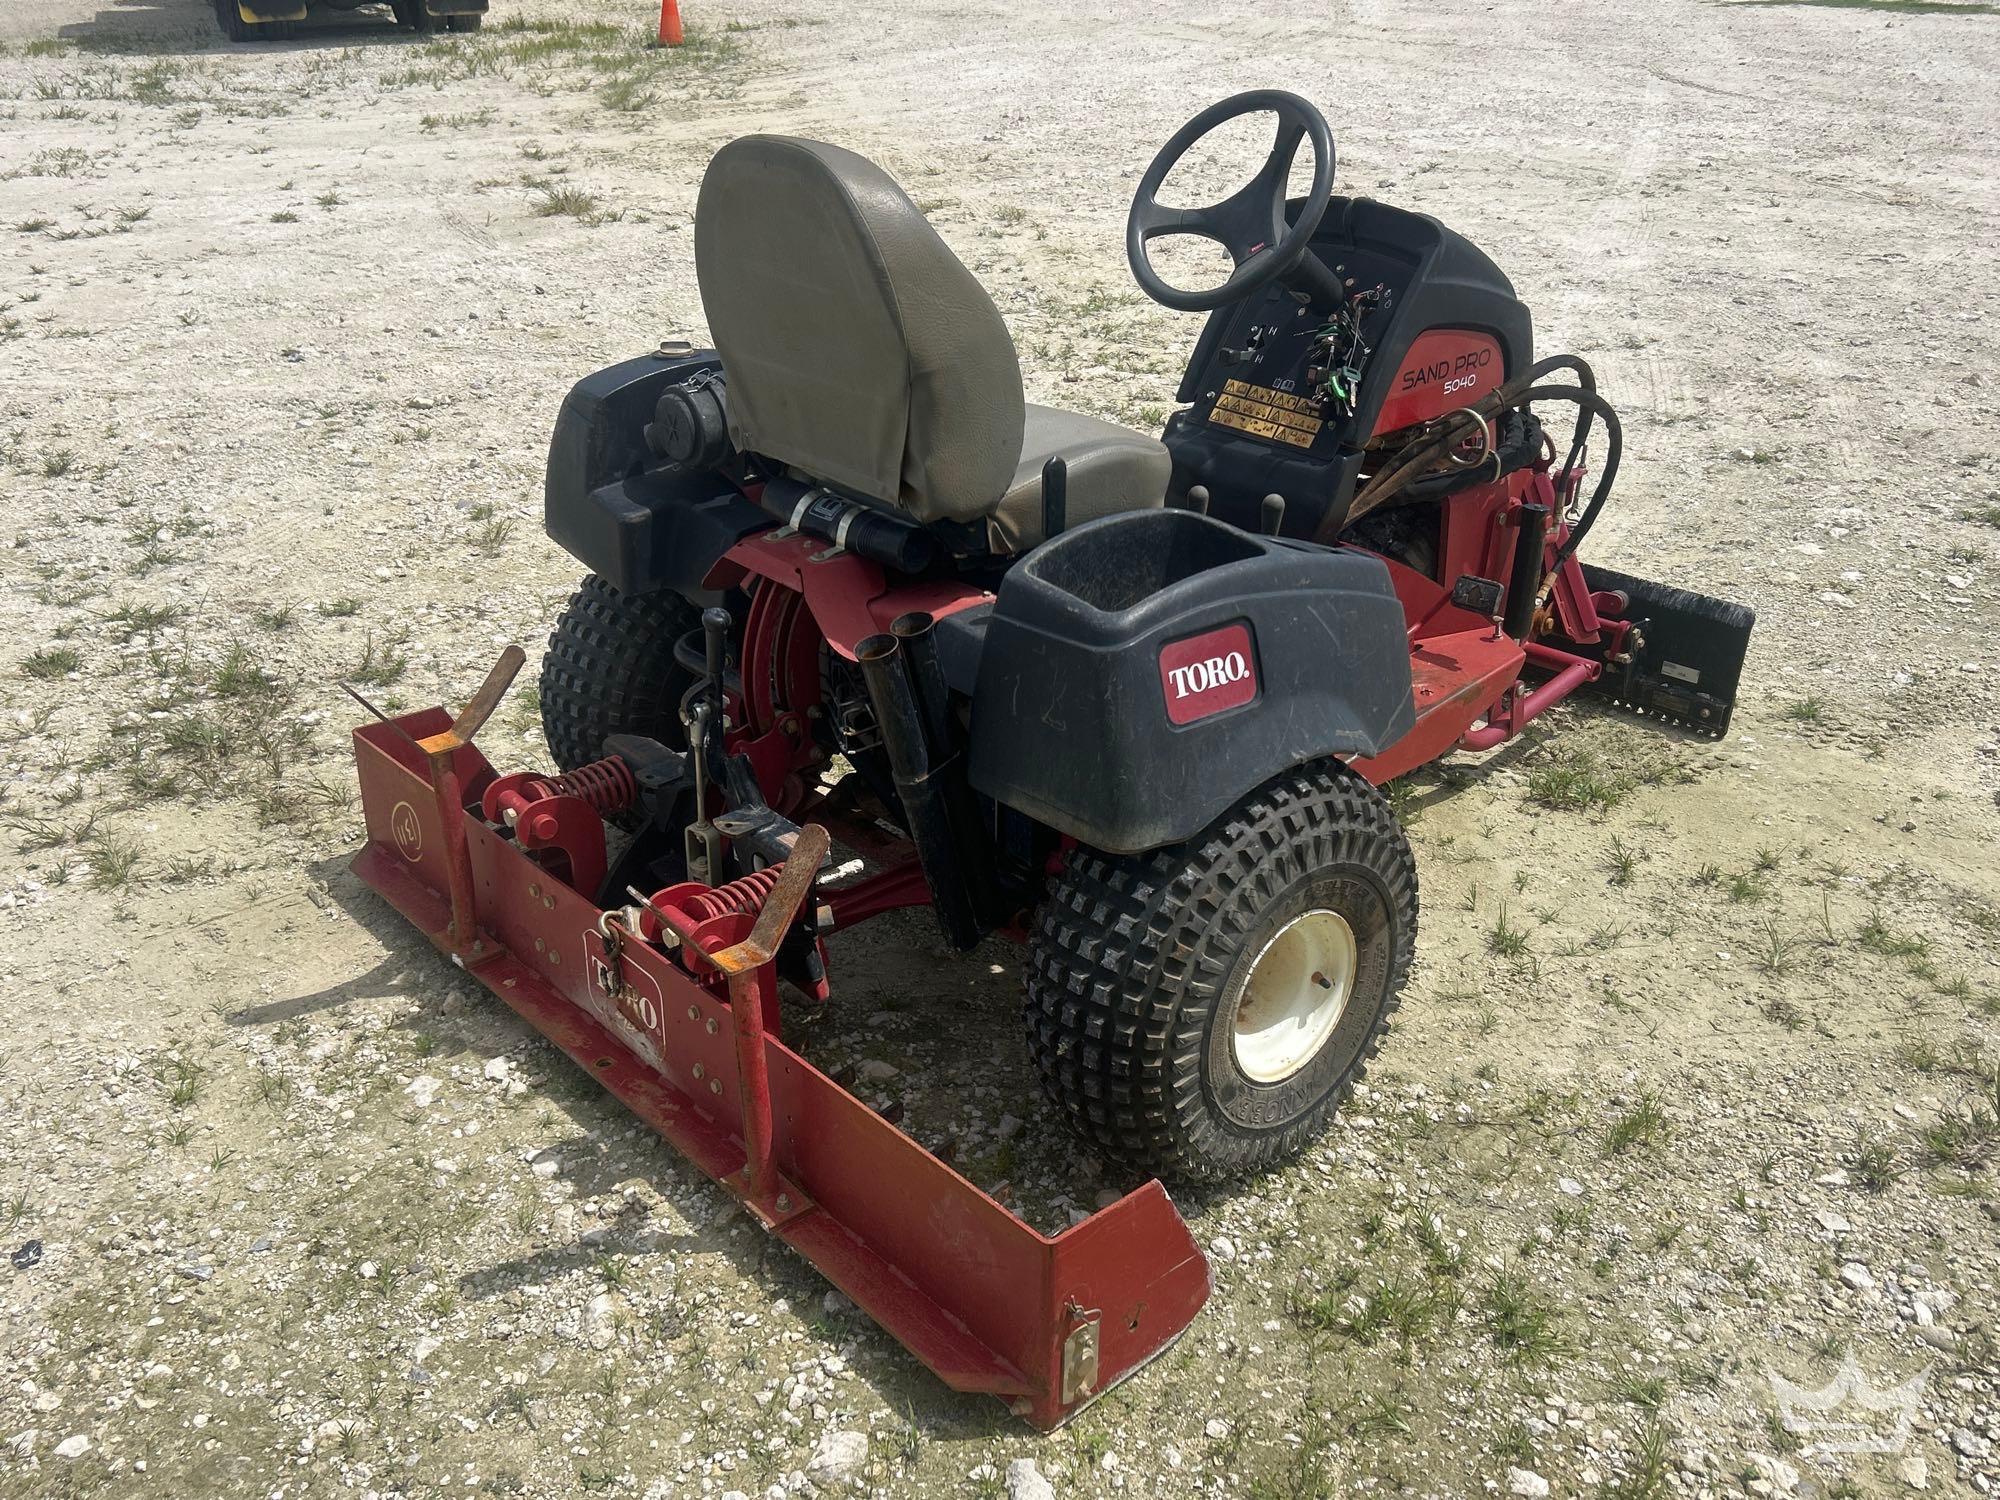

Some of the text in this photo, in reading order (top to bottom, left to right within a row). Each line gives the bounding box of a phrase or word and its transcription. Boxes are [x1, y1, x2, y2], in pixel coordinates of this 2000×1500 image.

[1402, 348, 1491, 391] SAND PRO
[1443, 374, 1476, 395] 5040
